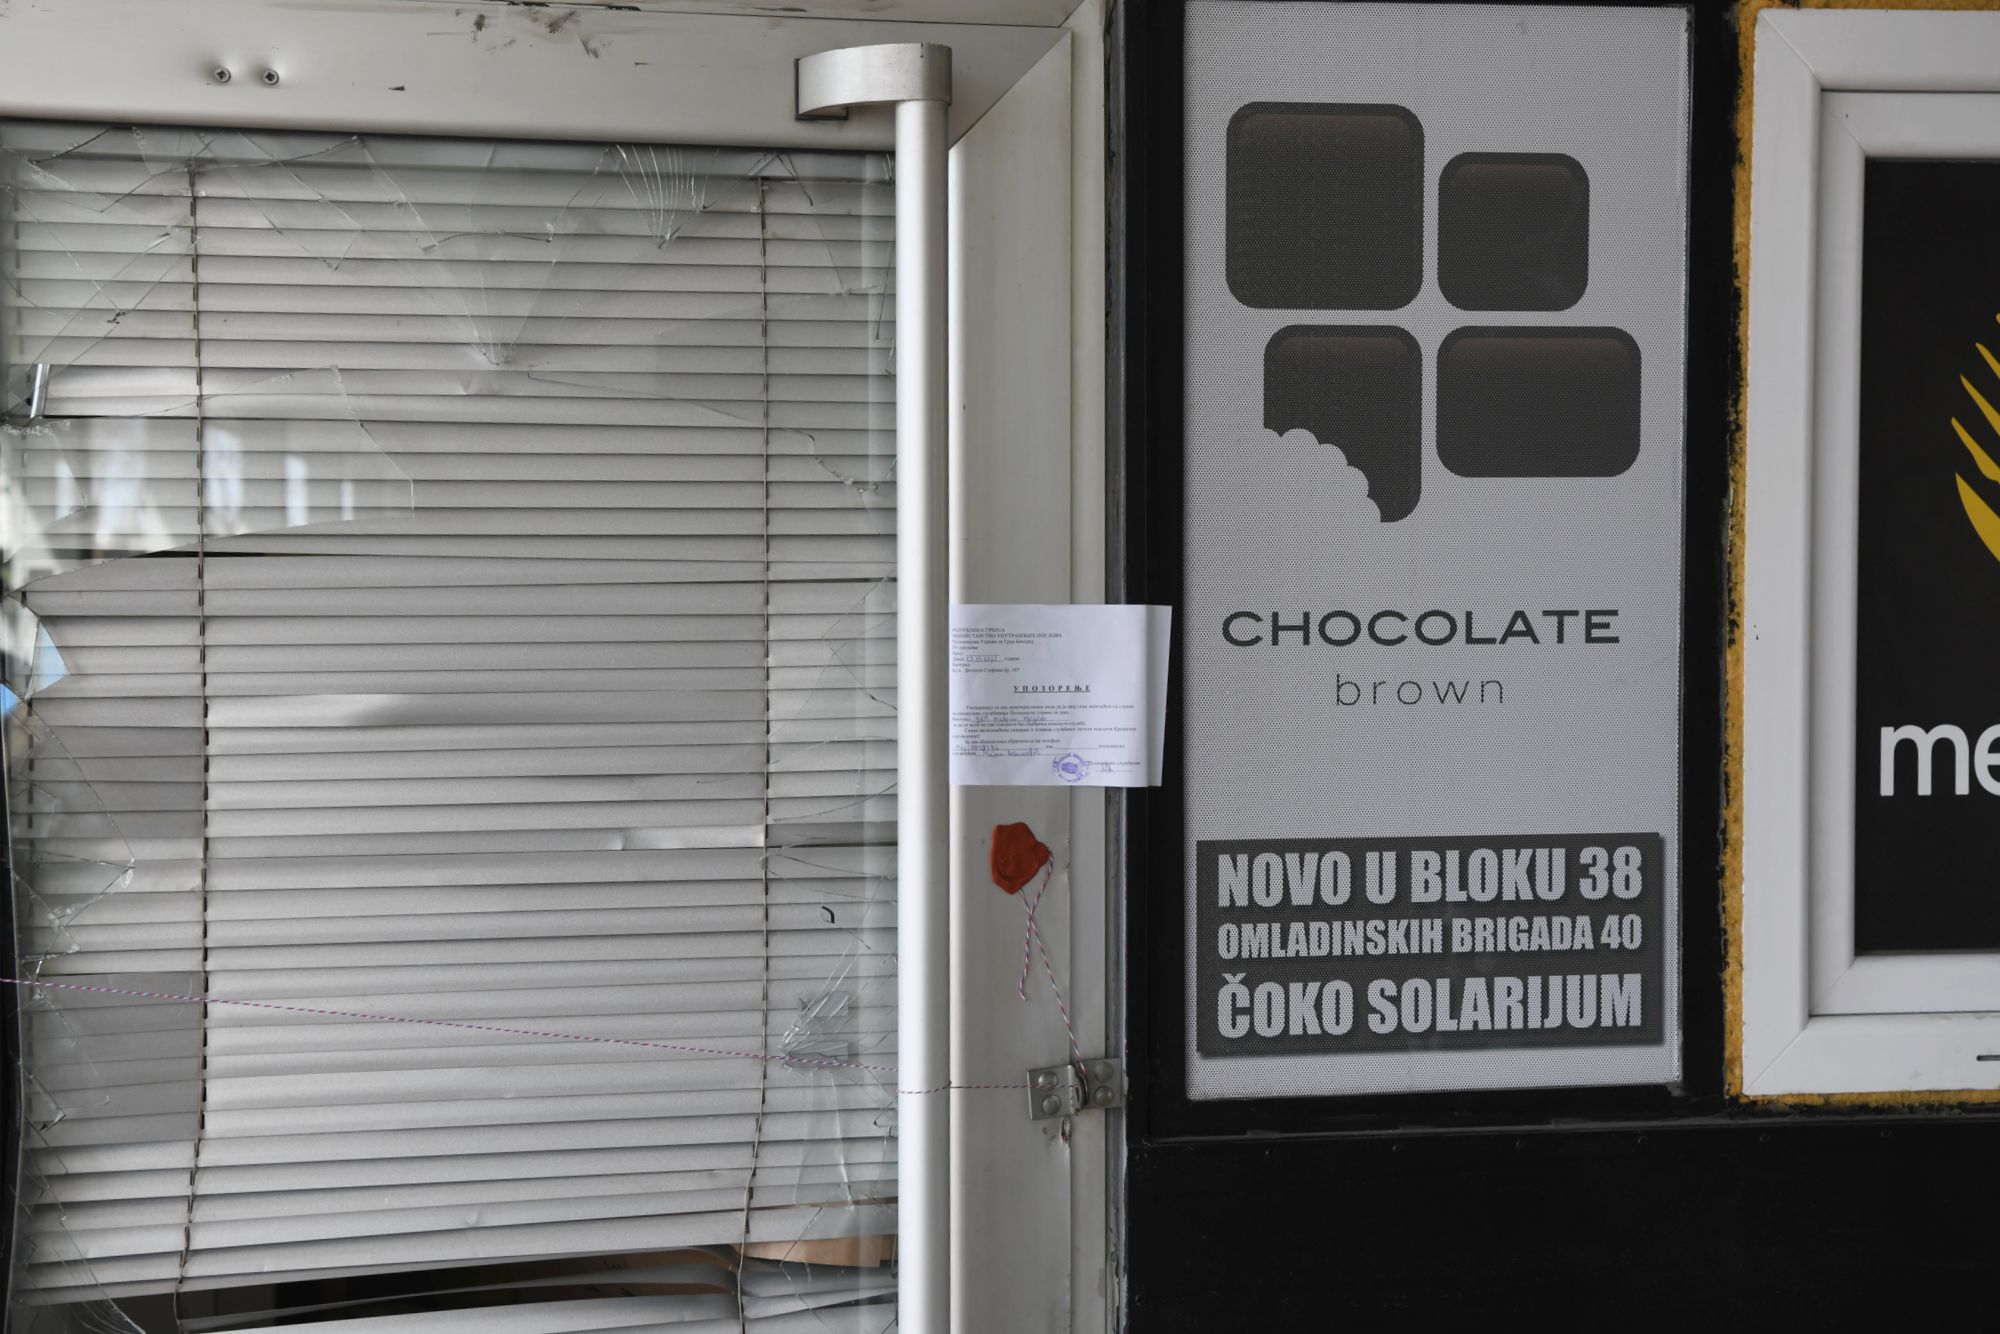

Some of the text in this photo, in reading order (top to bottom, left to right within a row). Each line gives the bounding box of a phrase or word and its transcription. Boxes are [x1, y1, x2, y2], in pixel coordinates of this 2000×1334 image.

[1222, 609, 1620, 647] CHOCOLATE
[1336, 673, 1504, 706] brown
[1217, 845, 1643, 907] NOVO U BLOKU 38
[1217, 913, 1642, 960] OMLADINSKIH BRIGADA 40
[1217, 972, 1643, 1039] ČOKO SOLARIJUM
